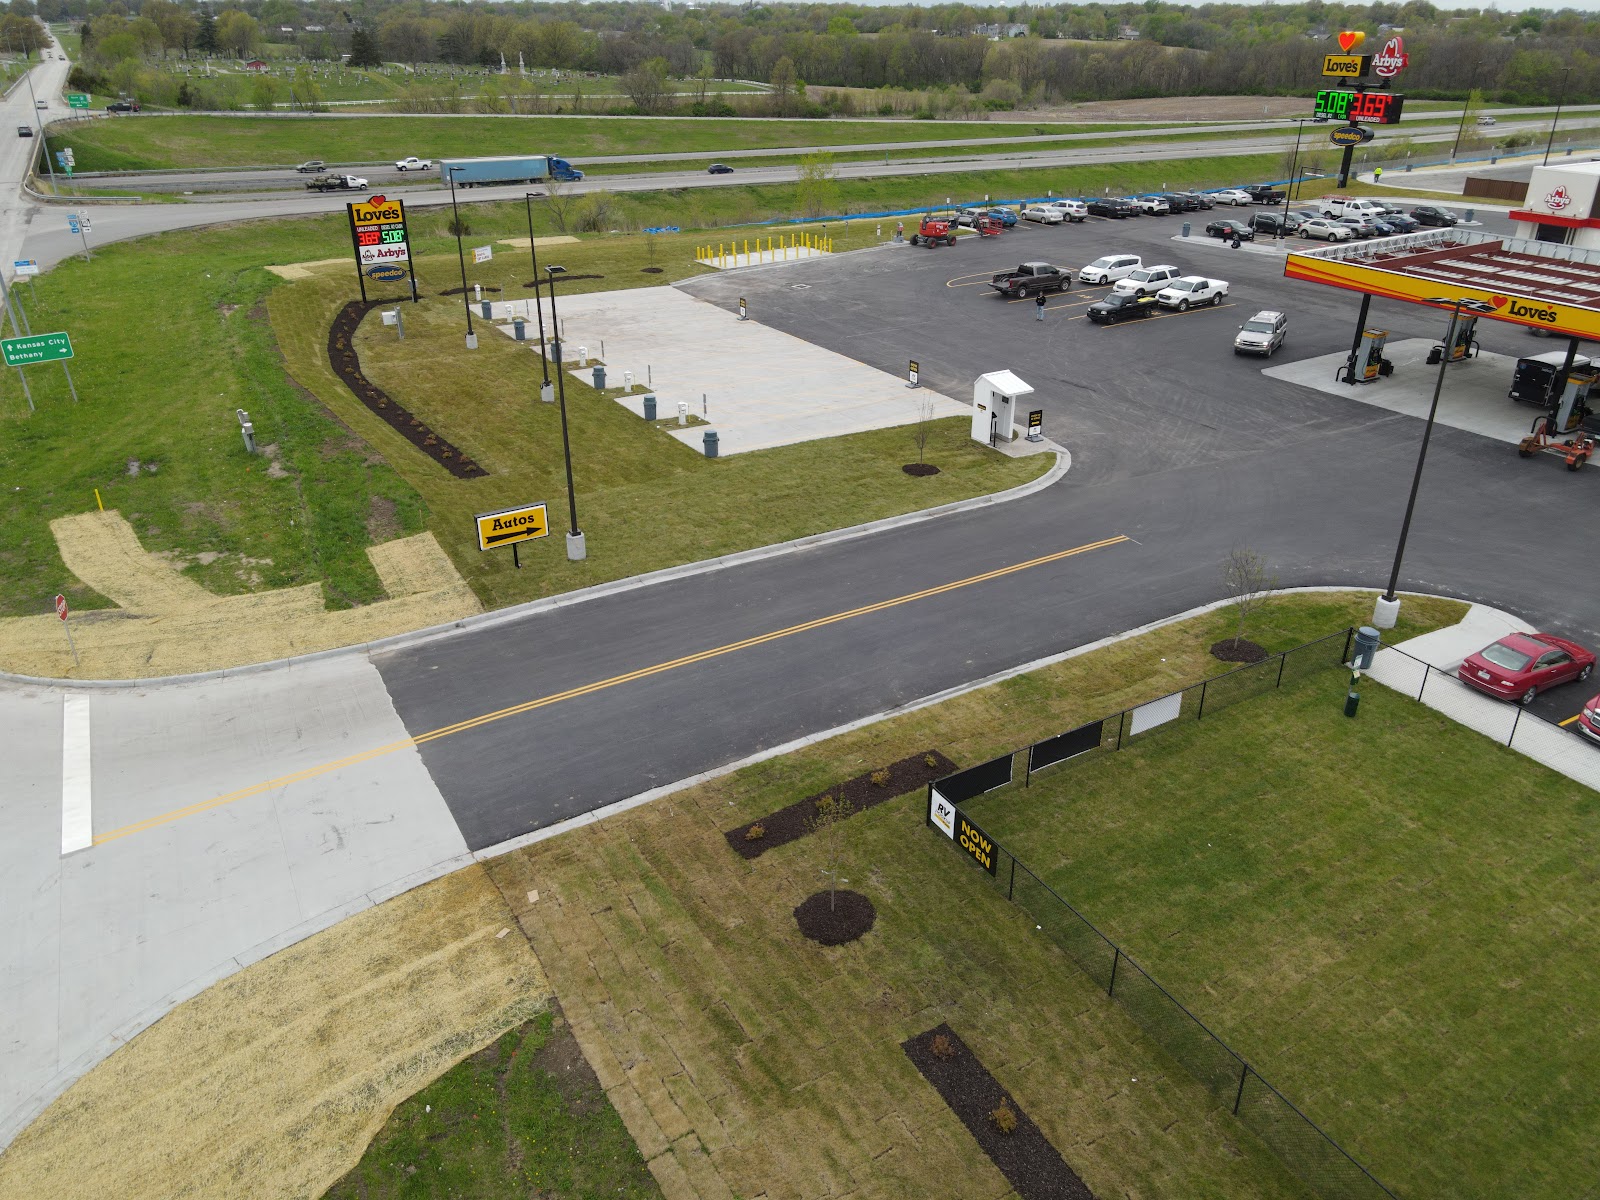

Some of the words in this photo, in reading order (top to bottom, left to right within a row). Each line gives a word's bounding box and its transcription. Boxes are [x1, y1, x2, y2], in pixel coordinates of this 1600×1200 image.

[1326, 59, 1358, 73] Love's
[1372, 54, 1403, 69] Arby's
[1545, 194, 1570, 205] Arby's
[355, 207, 400, 222] Love's
[377, 247, 406, 259] Arby's
[372, 269, 403, 280] speedco
[1508, 301, 1557, 323] Love's
[16, 341, 45, 350] Kansas
[48, 338, 65, 346] City
[9, 351, 43, 361] Bethany
[492, 515, 535, 531] Autos
[938, 803, 950, 816] RV
[962, 820, 991, 853] NOW
[960, 835, 990, 868] OPEN
